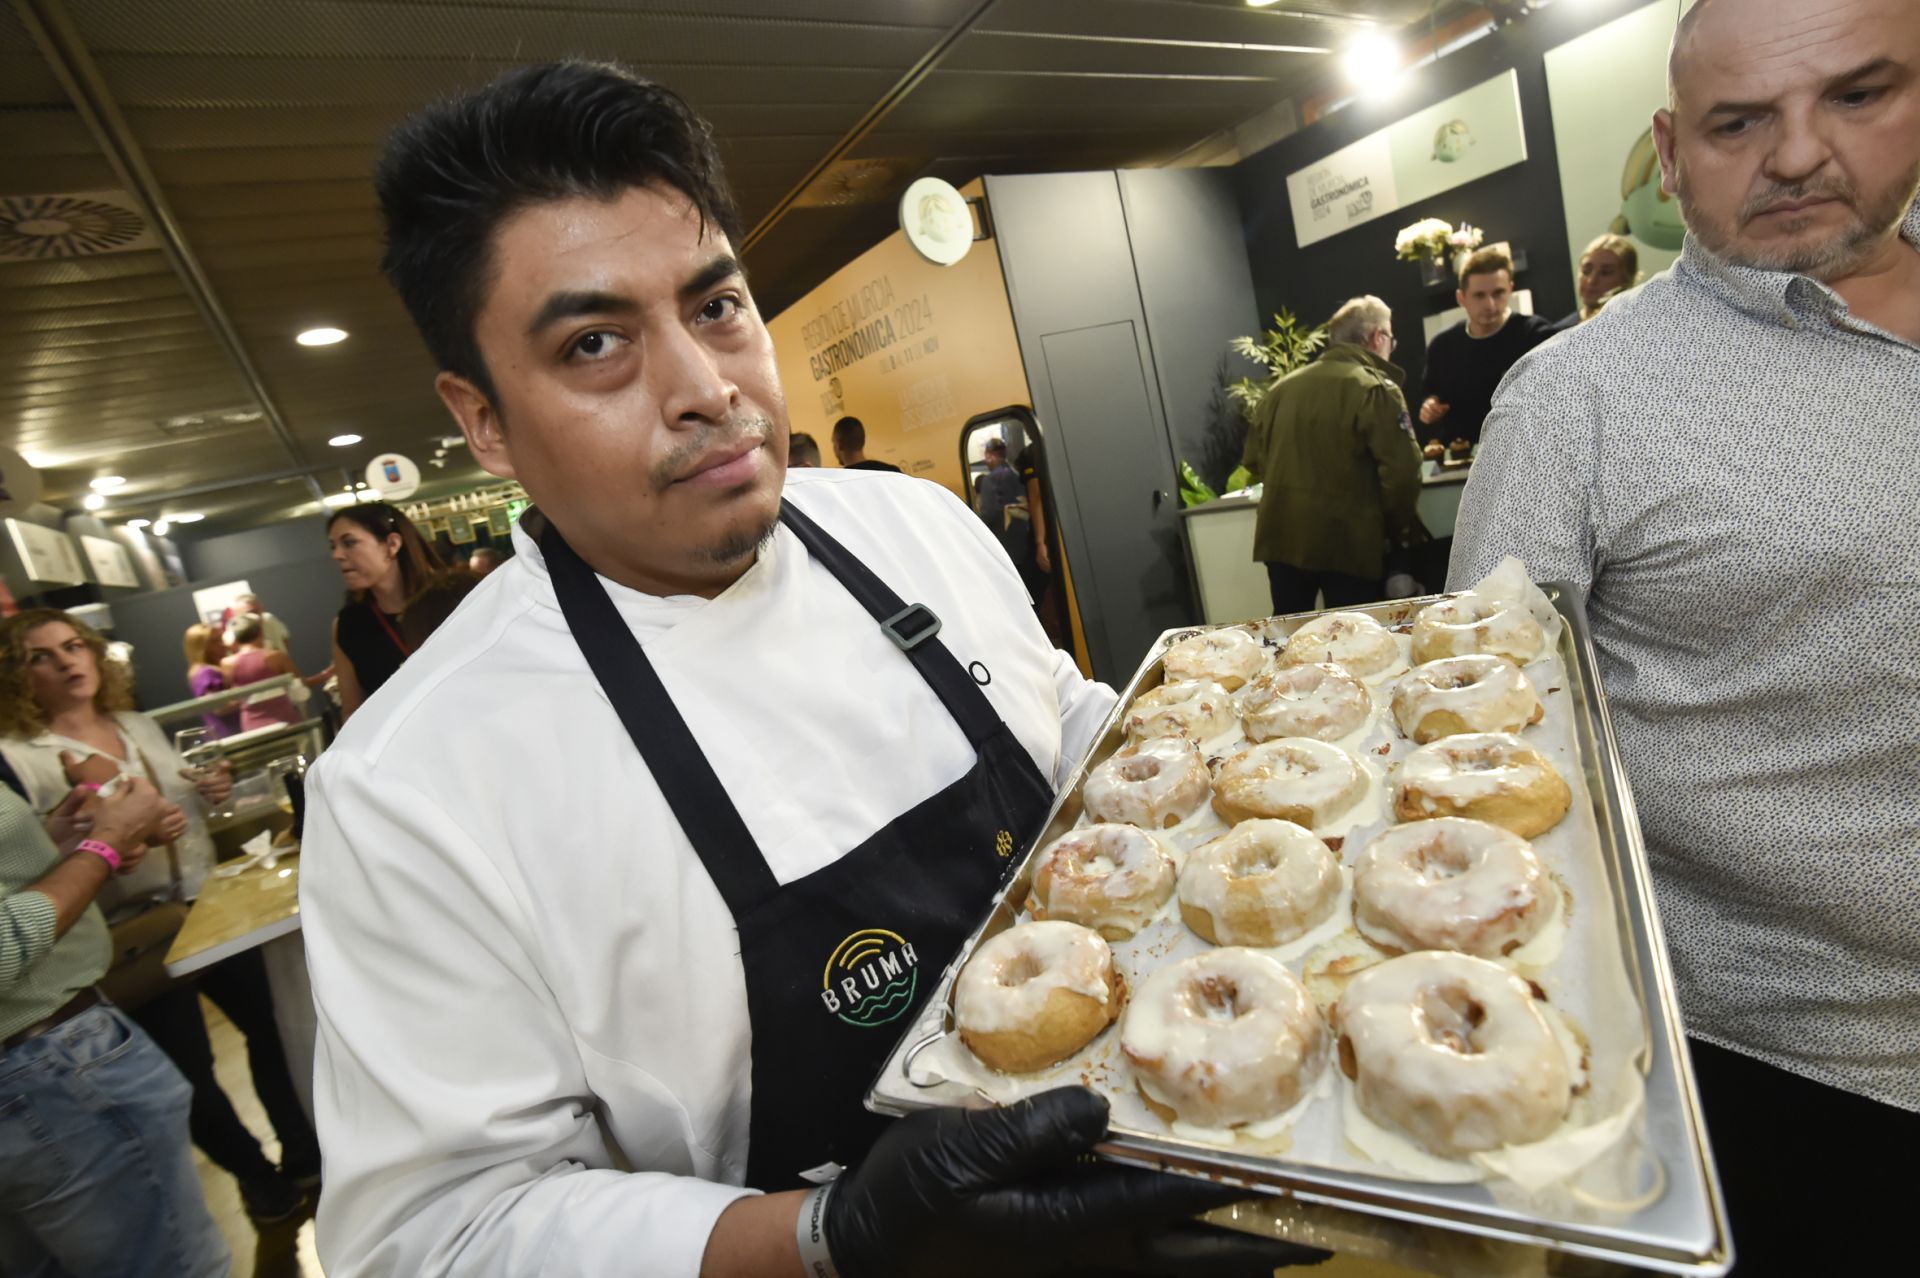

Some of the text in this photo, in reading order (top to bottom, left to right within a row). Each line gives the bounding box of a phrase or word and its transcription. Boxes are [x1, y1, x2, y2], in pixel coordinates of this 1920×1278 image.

[846, 275, 896, 329] MURCIA
[895, 294, 934, 340] 2024
[821, 943, 919, 1014] BRUMA
